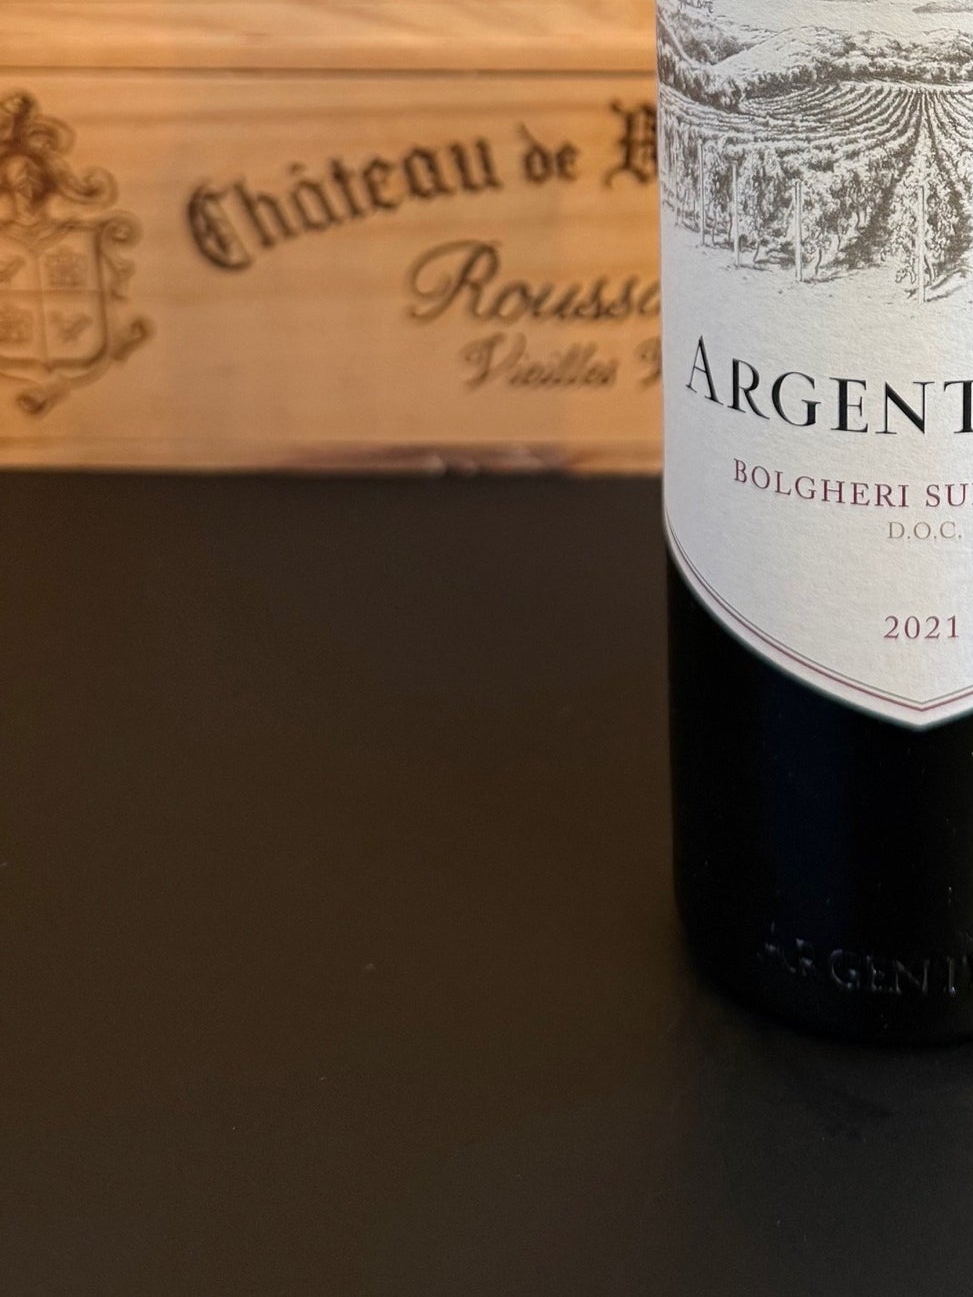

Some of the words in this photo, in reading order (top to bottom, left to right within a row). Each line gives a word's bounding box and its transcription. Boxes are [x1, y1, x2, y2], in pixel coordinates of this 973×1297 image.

[186, 136, 504, 273] Château
[517, 122, 582, 185] de
[732, 458, 910, 508] BOLGHERI
[887, 521, 963, 540] D.O.C.
[883, 615, 960, 640] 2021
